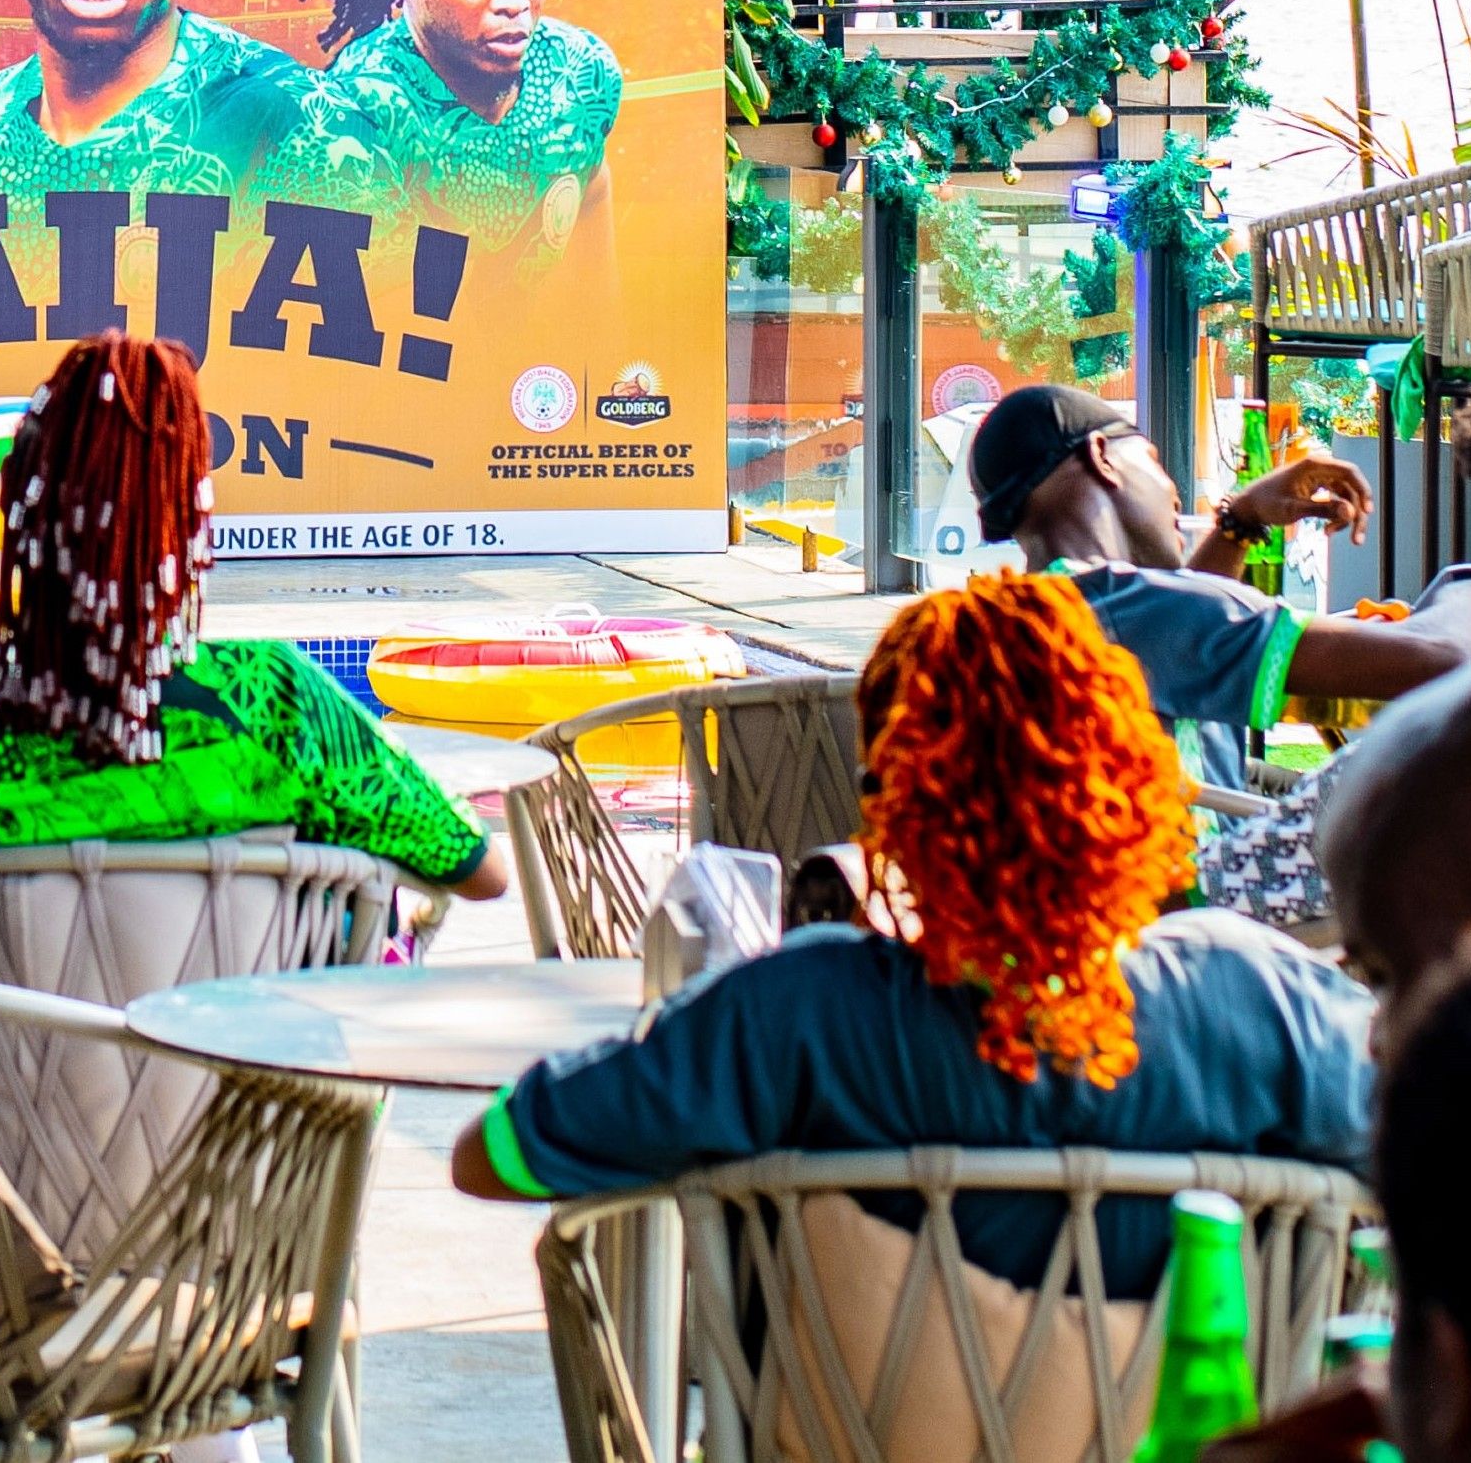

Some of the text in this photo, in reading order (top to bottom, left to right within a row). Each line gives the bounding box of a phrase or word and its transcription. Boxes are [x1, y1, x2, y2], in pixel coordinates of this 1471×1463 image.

[601, 401, 666, 416] GOLDBERG
[491, 444, 692, 459] OFFICIAL BEER OF
[488, 464, 694, 478] THE SUPER EAGLES
[210, 523, 504, 550] UNDER THE AGE OF 18.
